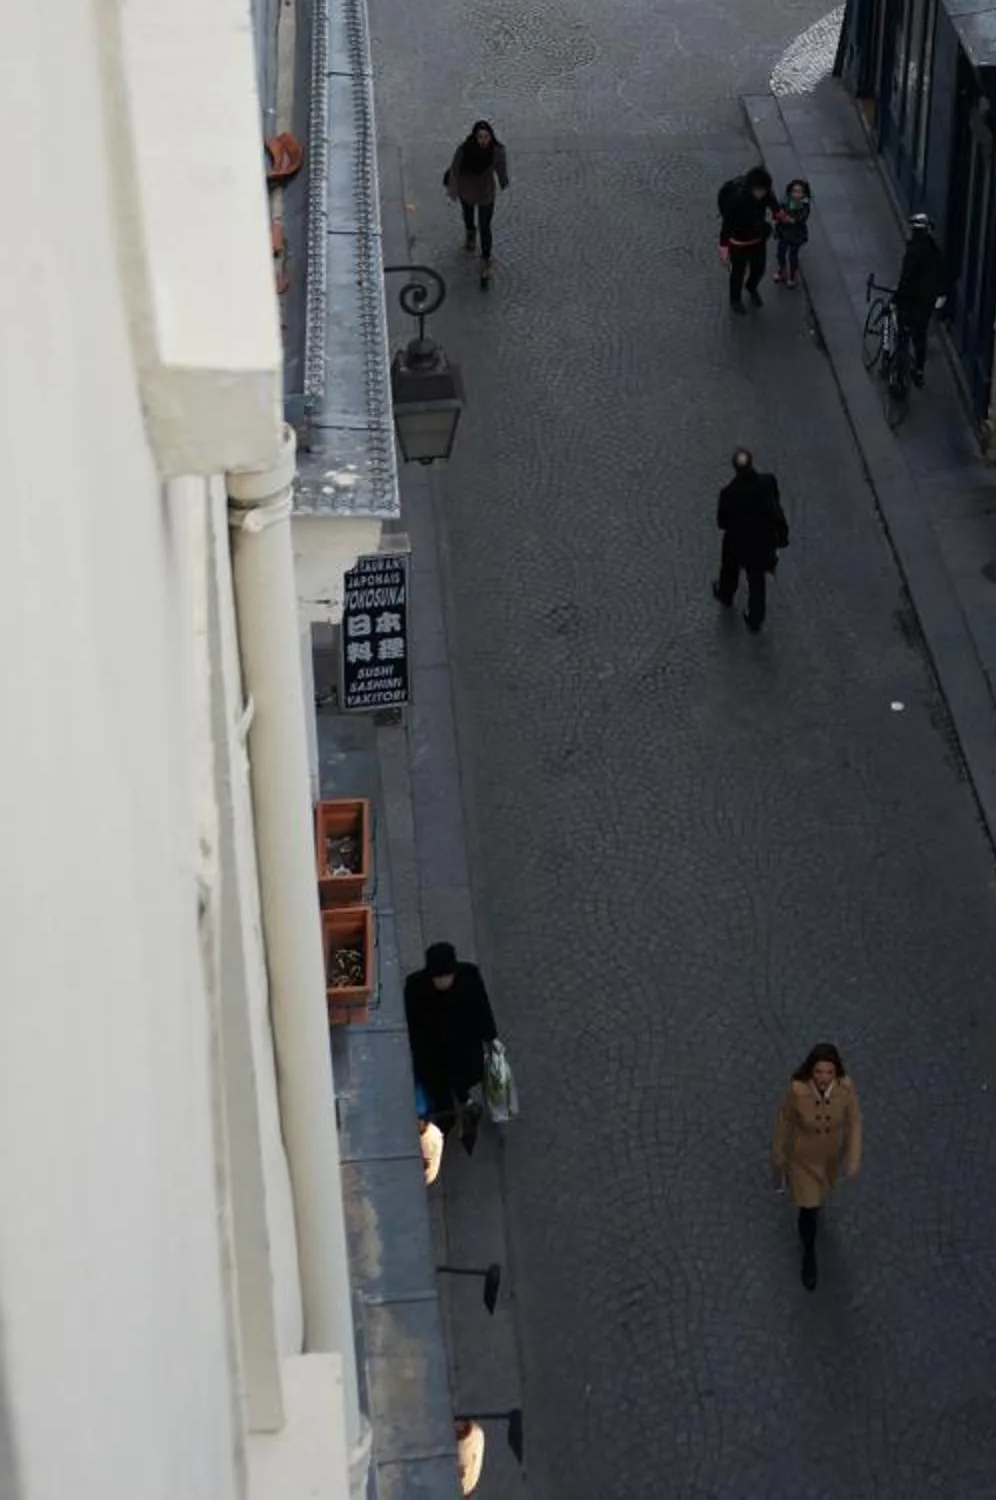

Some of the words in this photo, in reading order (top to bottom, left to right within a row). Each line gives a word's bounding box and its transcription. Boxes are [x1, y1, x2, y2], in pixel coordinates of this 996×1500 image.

[357, 665, 395, 679] SUSHI
[349, 677, 402, 693] SASHIMI
[347, 690, 406, 705] YAKITORI
